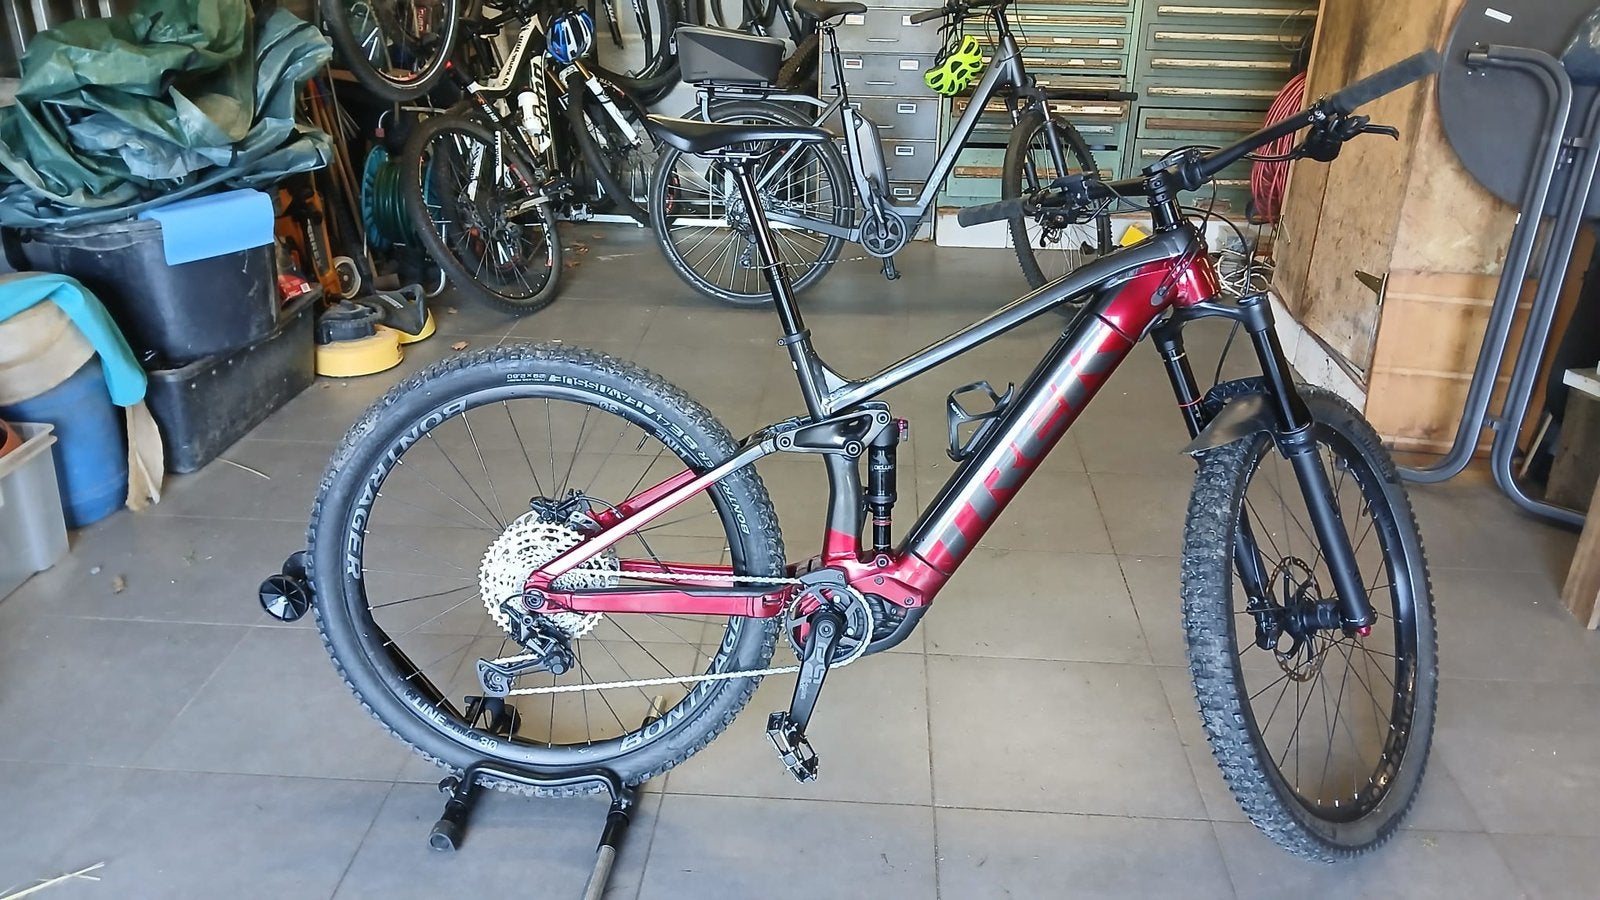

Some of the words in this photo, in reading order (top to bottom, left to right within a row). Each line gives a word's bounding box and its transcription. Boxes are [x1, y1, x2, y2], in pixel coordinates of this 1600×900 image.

[654, 429, 689, 458] LINE
[656, 413, 699, 450] SE4
[919, 338, 1121, 560] TREK
[346, 399, 468, 580] BONTRAGER
[412, 696, 447, 726] LINE
[480, 736, 499, 752] 30
